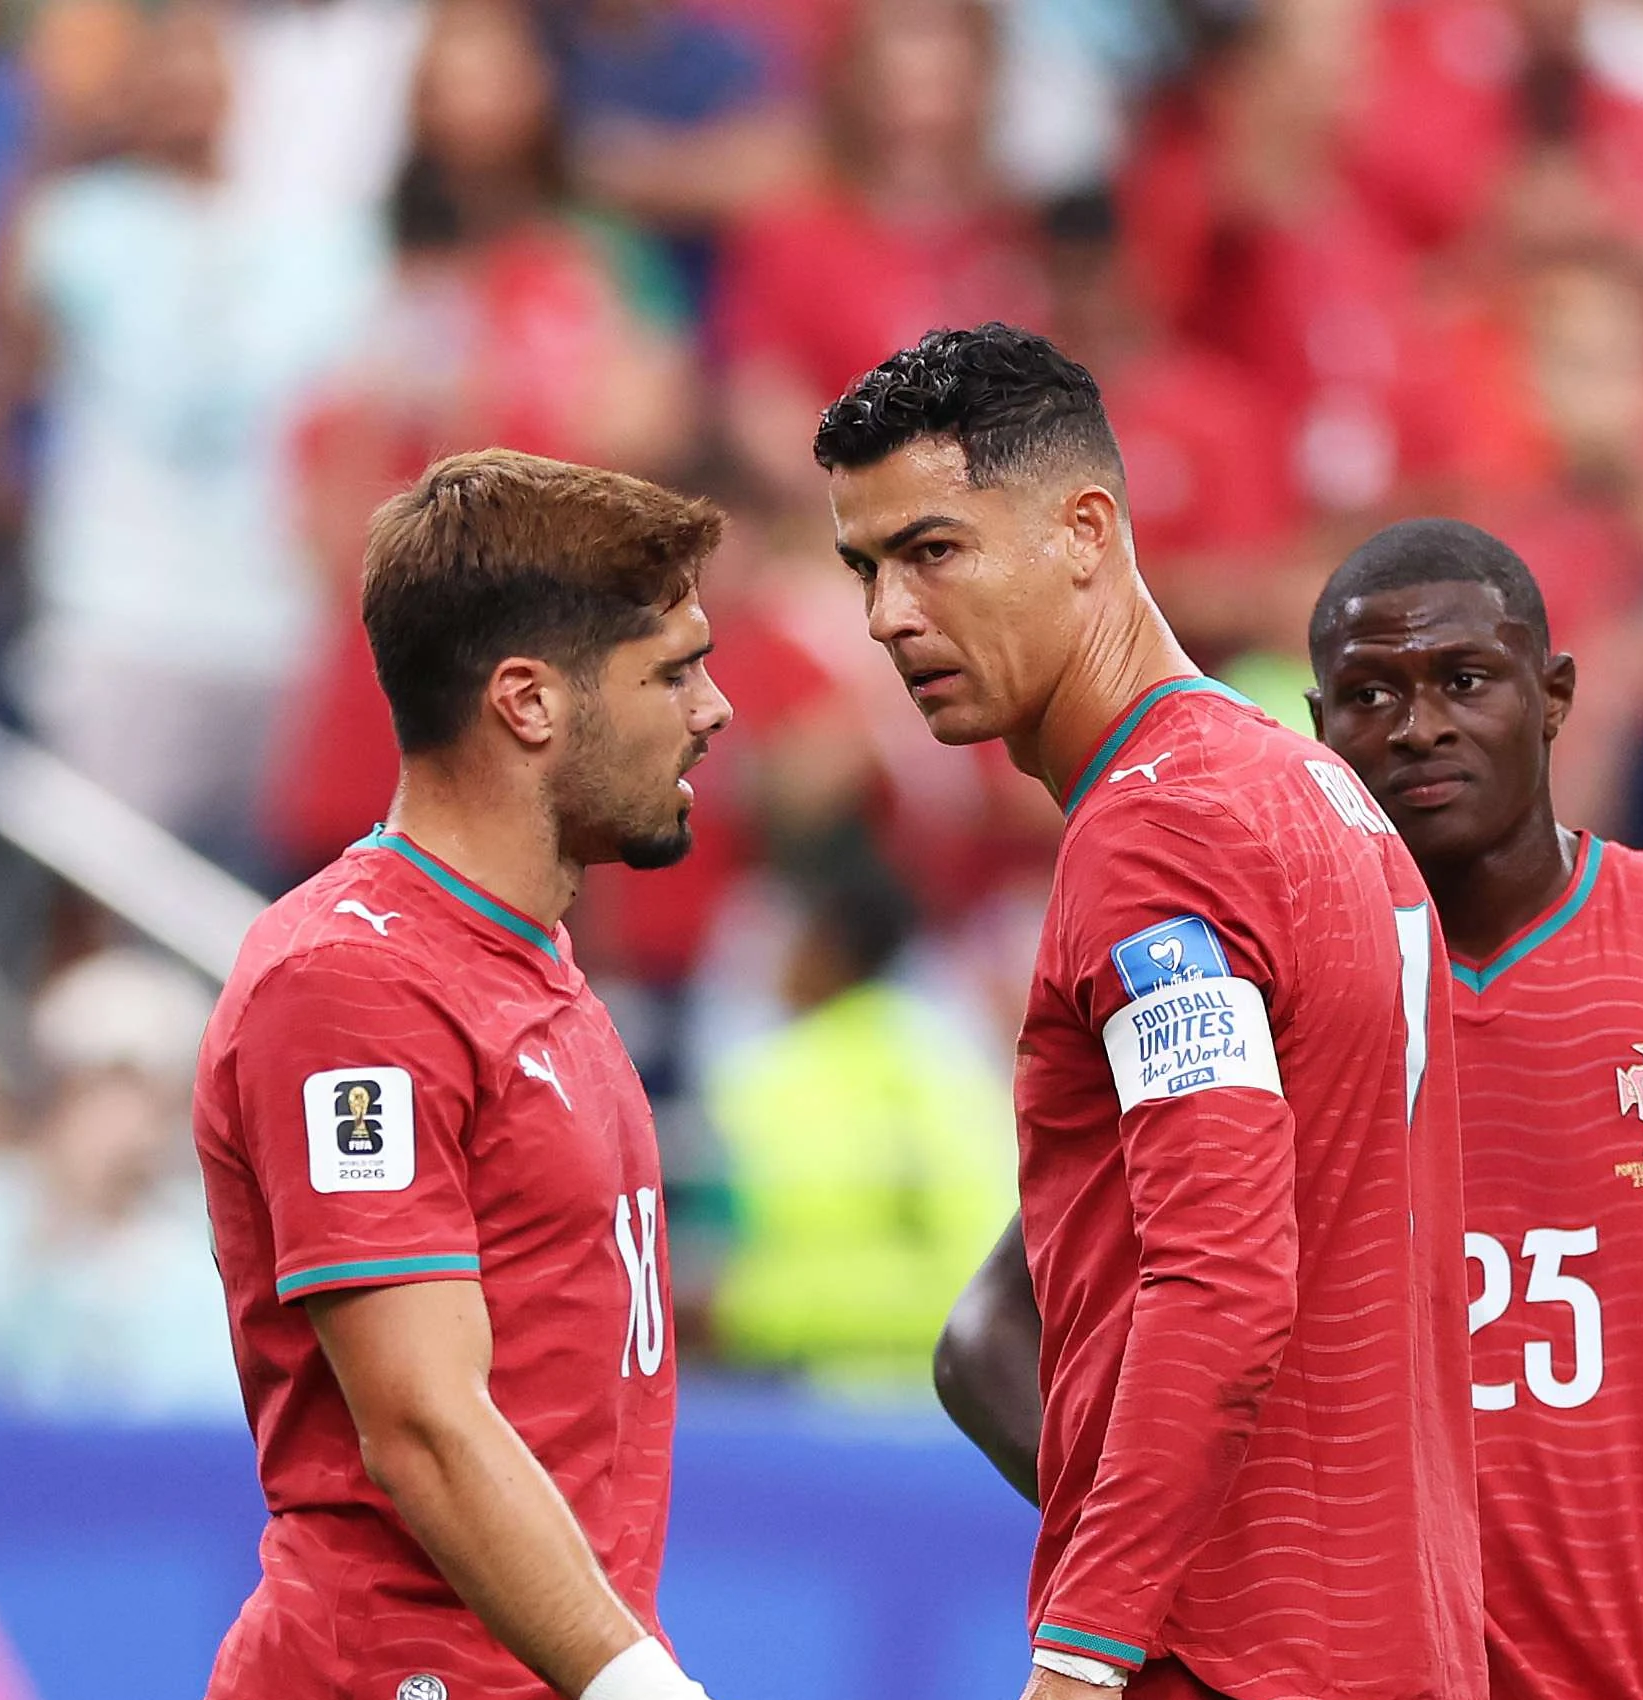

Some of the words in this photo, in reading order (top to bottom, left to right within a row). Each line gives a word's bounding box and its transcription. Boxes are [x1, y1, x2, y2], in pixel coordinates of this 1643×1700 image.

[1132, 990, 1233, 1035] FOOTBALL
[1138, 1010, 1235, 1062] UNITES
[1139, 1059, 1173, 1088] the
[1172, 1038, 1247, 1069] World
[1169, 1068, 1214, 1093] FIFA
[339, 1168, 386, 1180] 2026
[1463, 1225, 1604, 1411] 25
